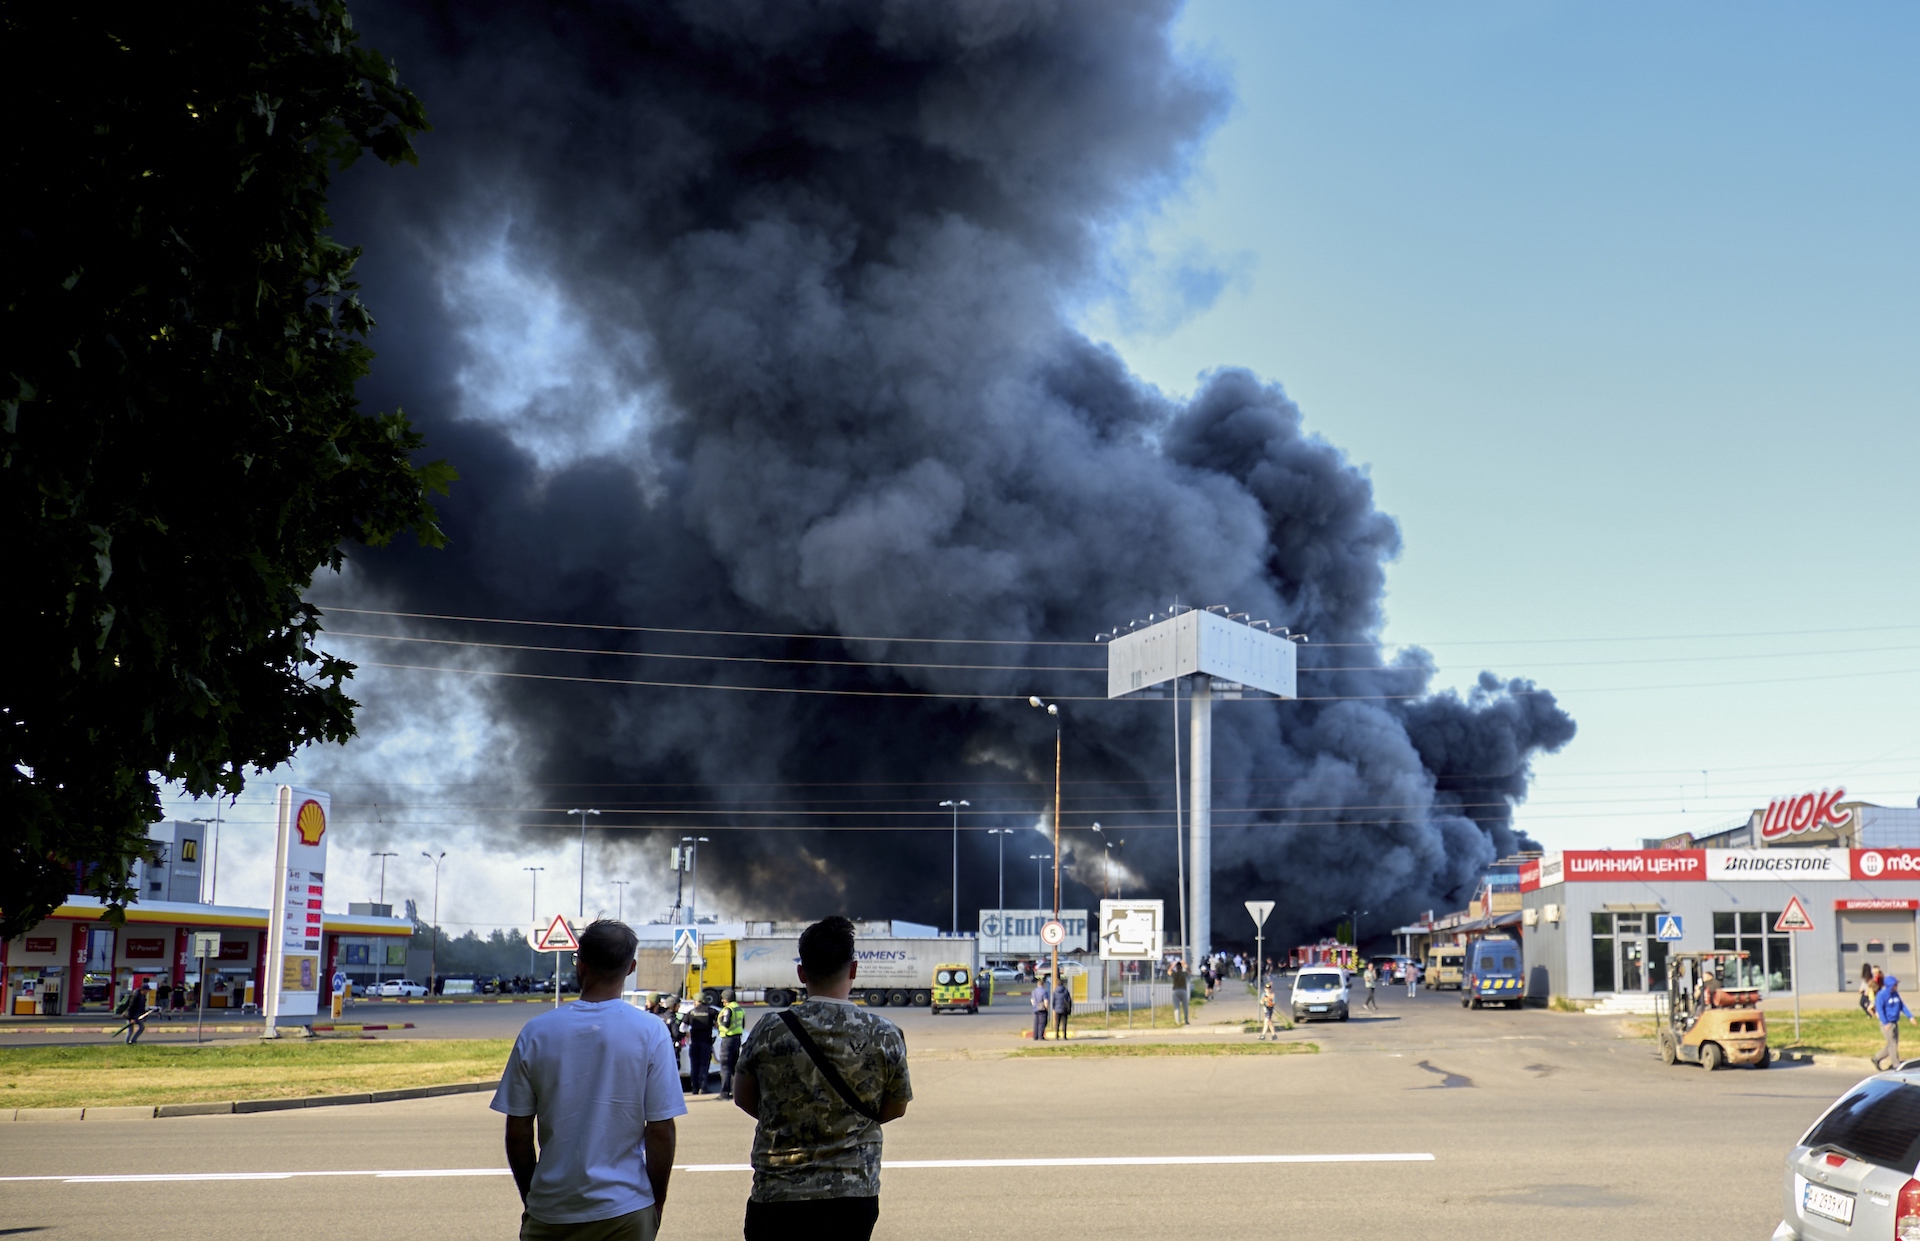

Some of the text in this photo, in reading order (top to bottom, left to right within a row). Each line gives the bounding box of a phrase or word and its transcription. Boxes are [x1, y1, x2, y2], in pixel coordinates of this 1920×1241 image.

[1762, 789, 1852, 838] ШОК
[1570, 855, 1645, 873] ШИННИЙ
[1647, 858, 1699, 875] ЦЕНТР
[1724, 857, 1832, 871] BRIDGESTONE
[1847, 900, 1910, 910] ШИНОМОНТАЖ
[1005, 916, 1085, 937] ЕПІЦТР
[1050, 928, 1056, 938] 5
[853, 951, 906, 960] EWMEN'S
